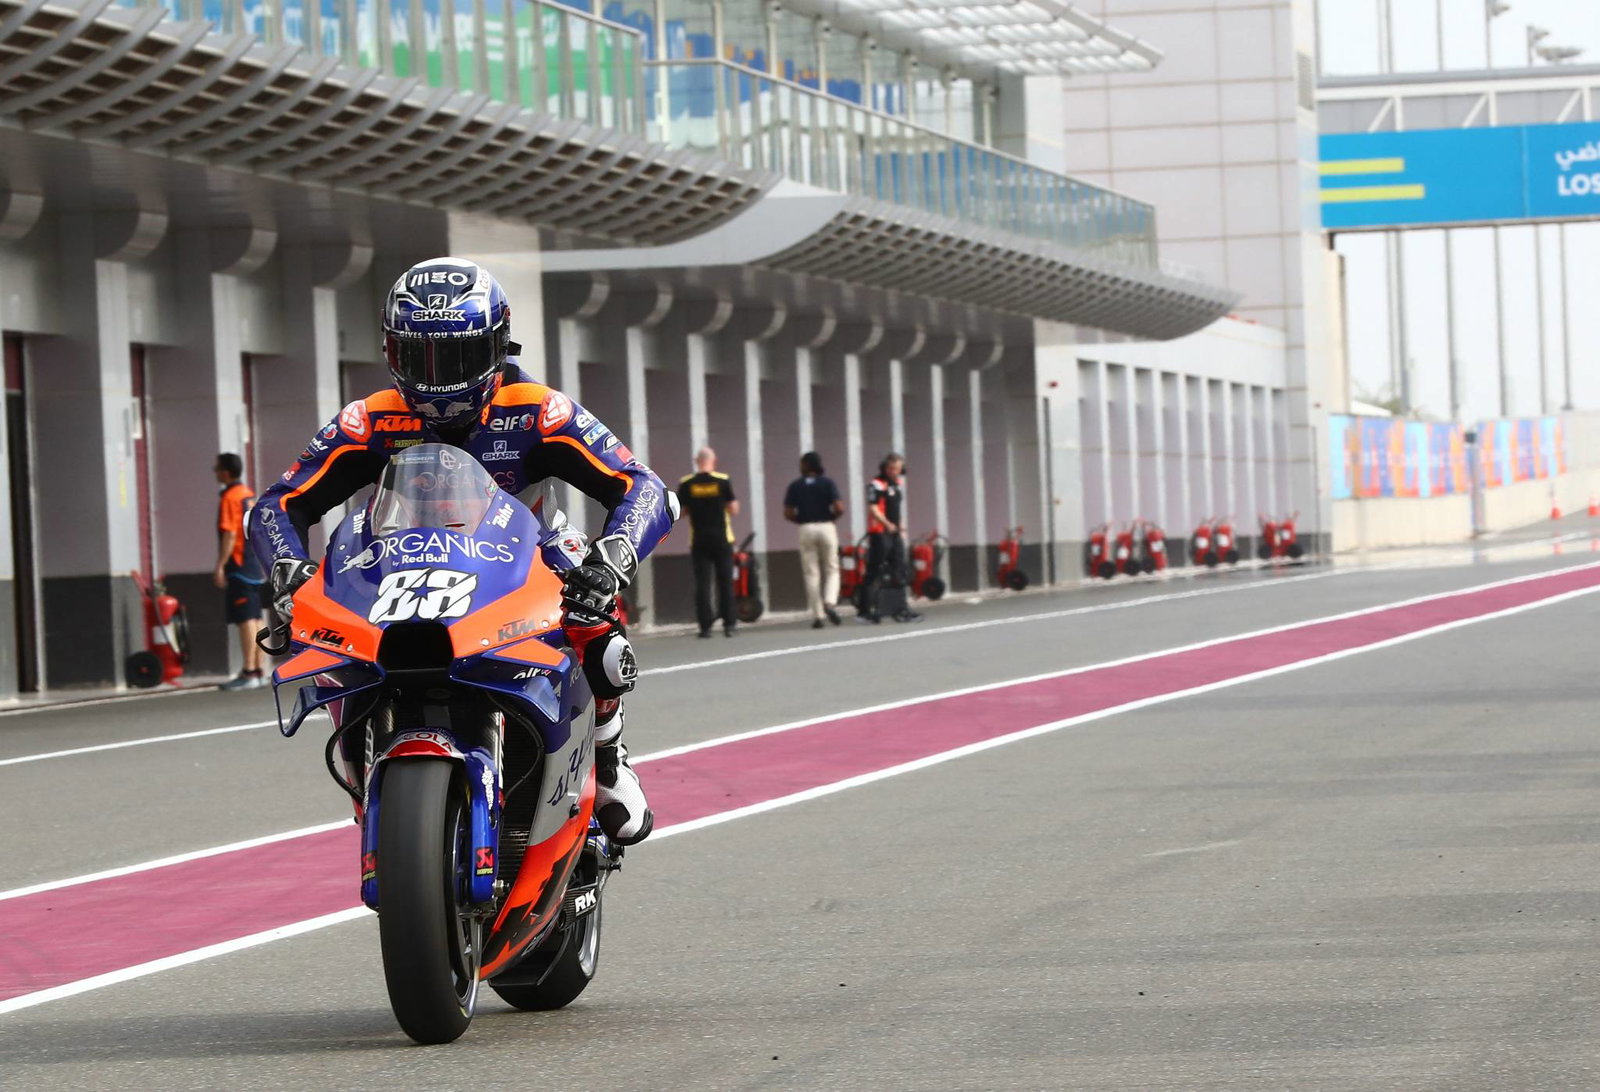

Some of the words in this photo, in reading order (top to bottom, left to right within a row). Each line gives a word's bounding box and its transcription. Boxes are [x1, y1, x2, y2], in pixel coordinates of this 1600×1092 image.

[410, 272, 469, 287] MEO
[412, 310, 465, 321] SHARK
[399, 331, 422, 339] GIVES
[427, 331, 448, 339] YOU
[453, 329, 483, 338] WINGS
[430, 382, 468, 392] HYUNDAI
[374, 415, 422, 431] KTM
[490, 415, 521, 431] elf
[482, 450, 520, 461] SHARK
[361, 532, 514, 569] ORGANICS
[401, 553, 424, 564] Red
[426, 553, 448, 563] Bull
[368, 567, 478, 624] 88
[310, 628, 345, 645] KTM
[498, 619, 537, 641] KTM
[575, 889, 597, 913] RK
